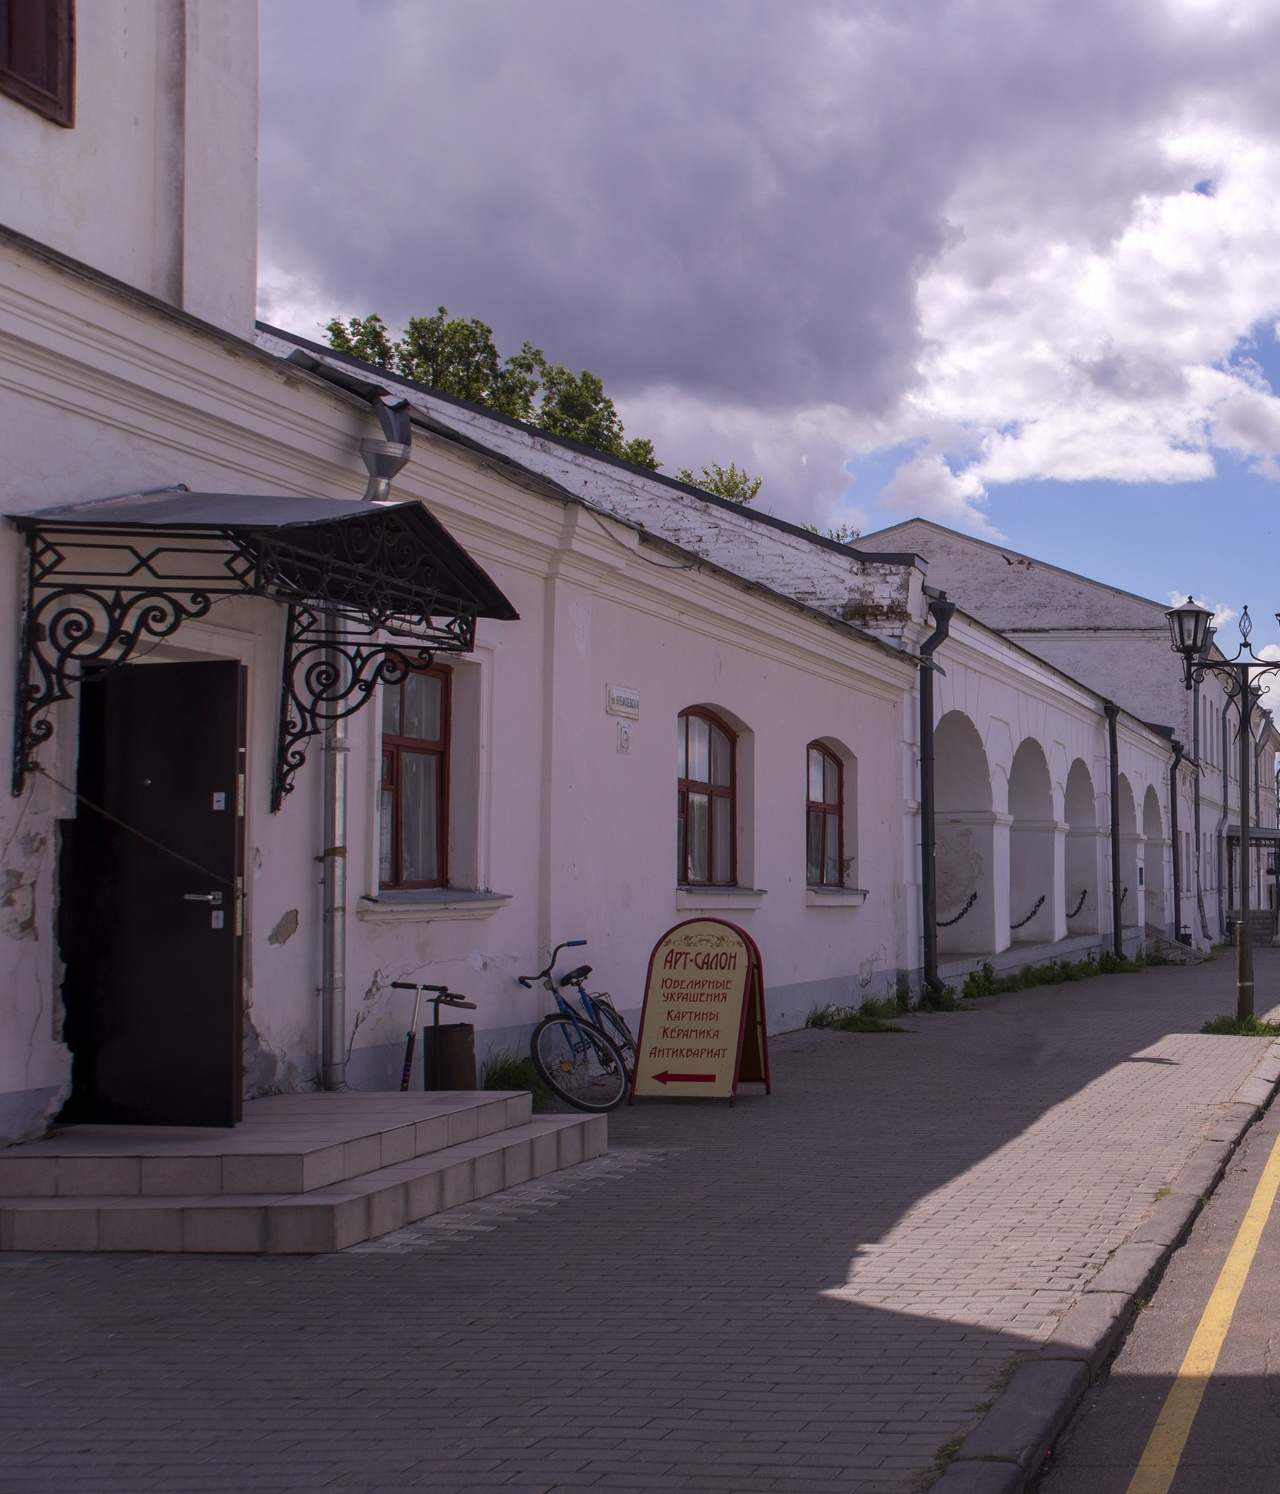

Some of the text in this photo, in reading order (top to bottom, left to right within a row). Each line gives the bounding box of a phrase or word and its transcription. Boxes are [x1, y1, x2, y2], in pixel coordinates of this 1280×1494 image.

[661, 978, 732, 990] ЮВЕЛИРНЫЕ
[662, 992, 727, 1002] УКРАШЕНИЯ
[666, 1010, 719, 1021] КАРТИНЫ
[662, 1027, 720, 1039] КЕРАМИКА
[649, 1046, 728, 1059] АНТИКВАРИАТ
